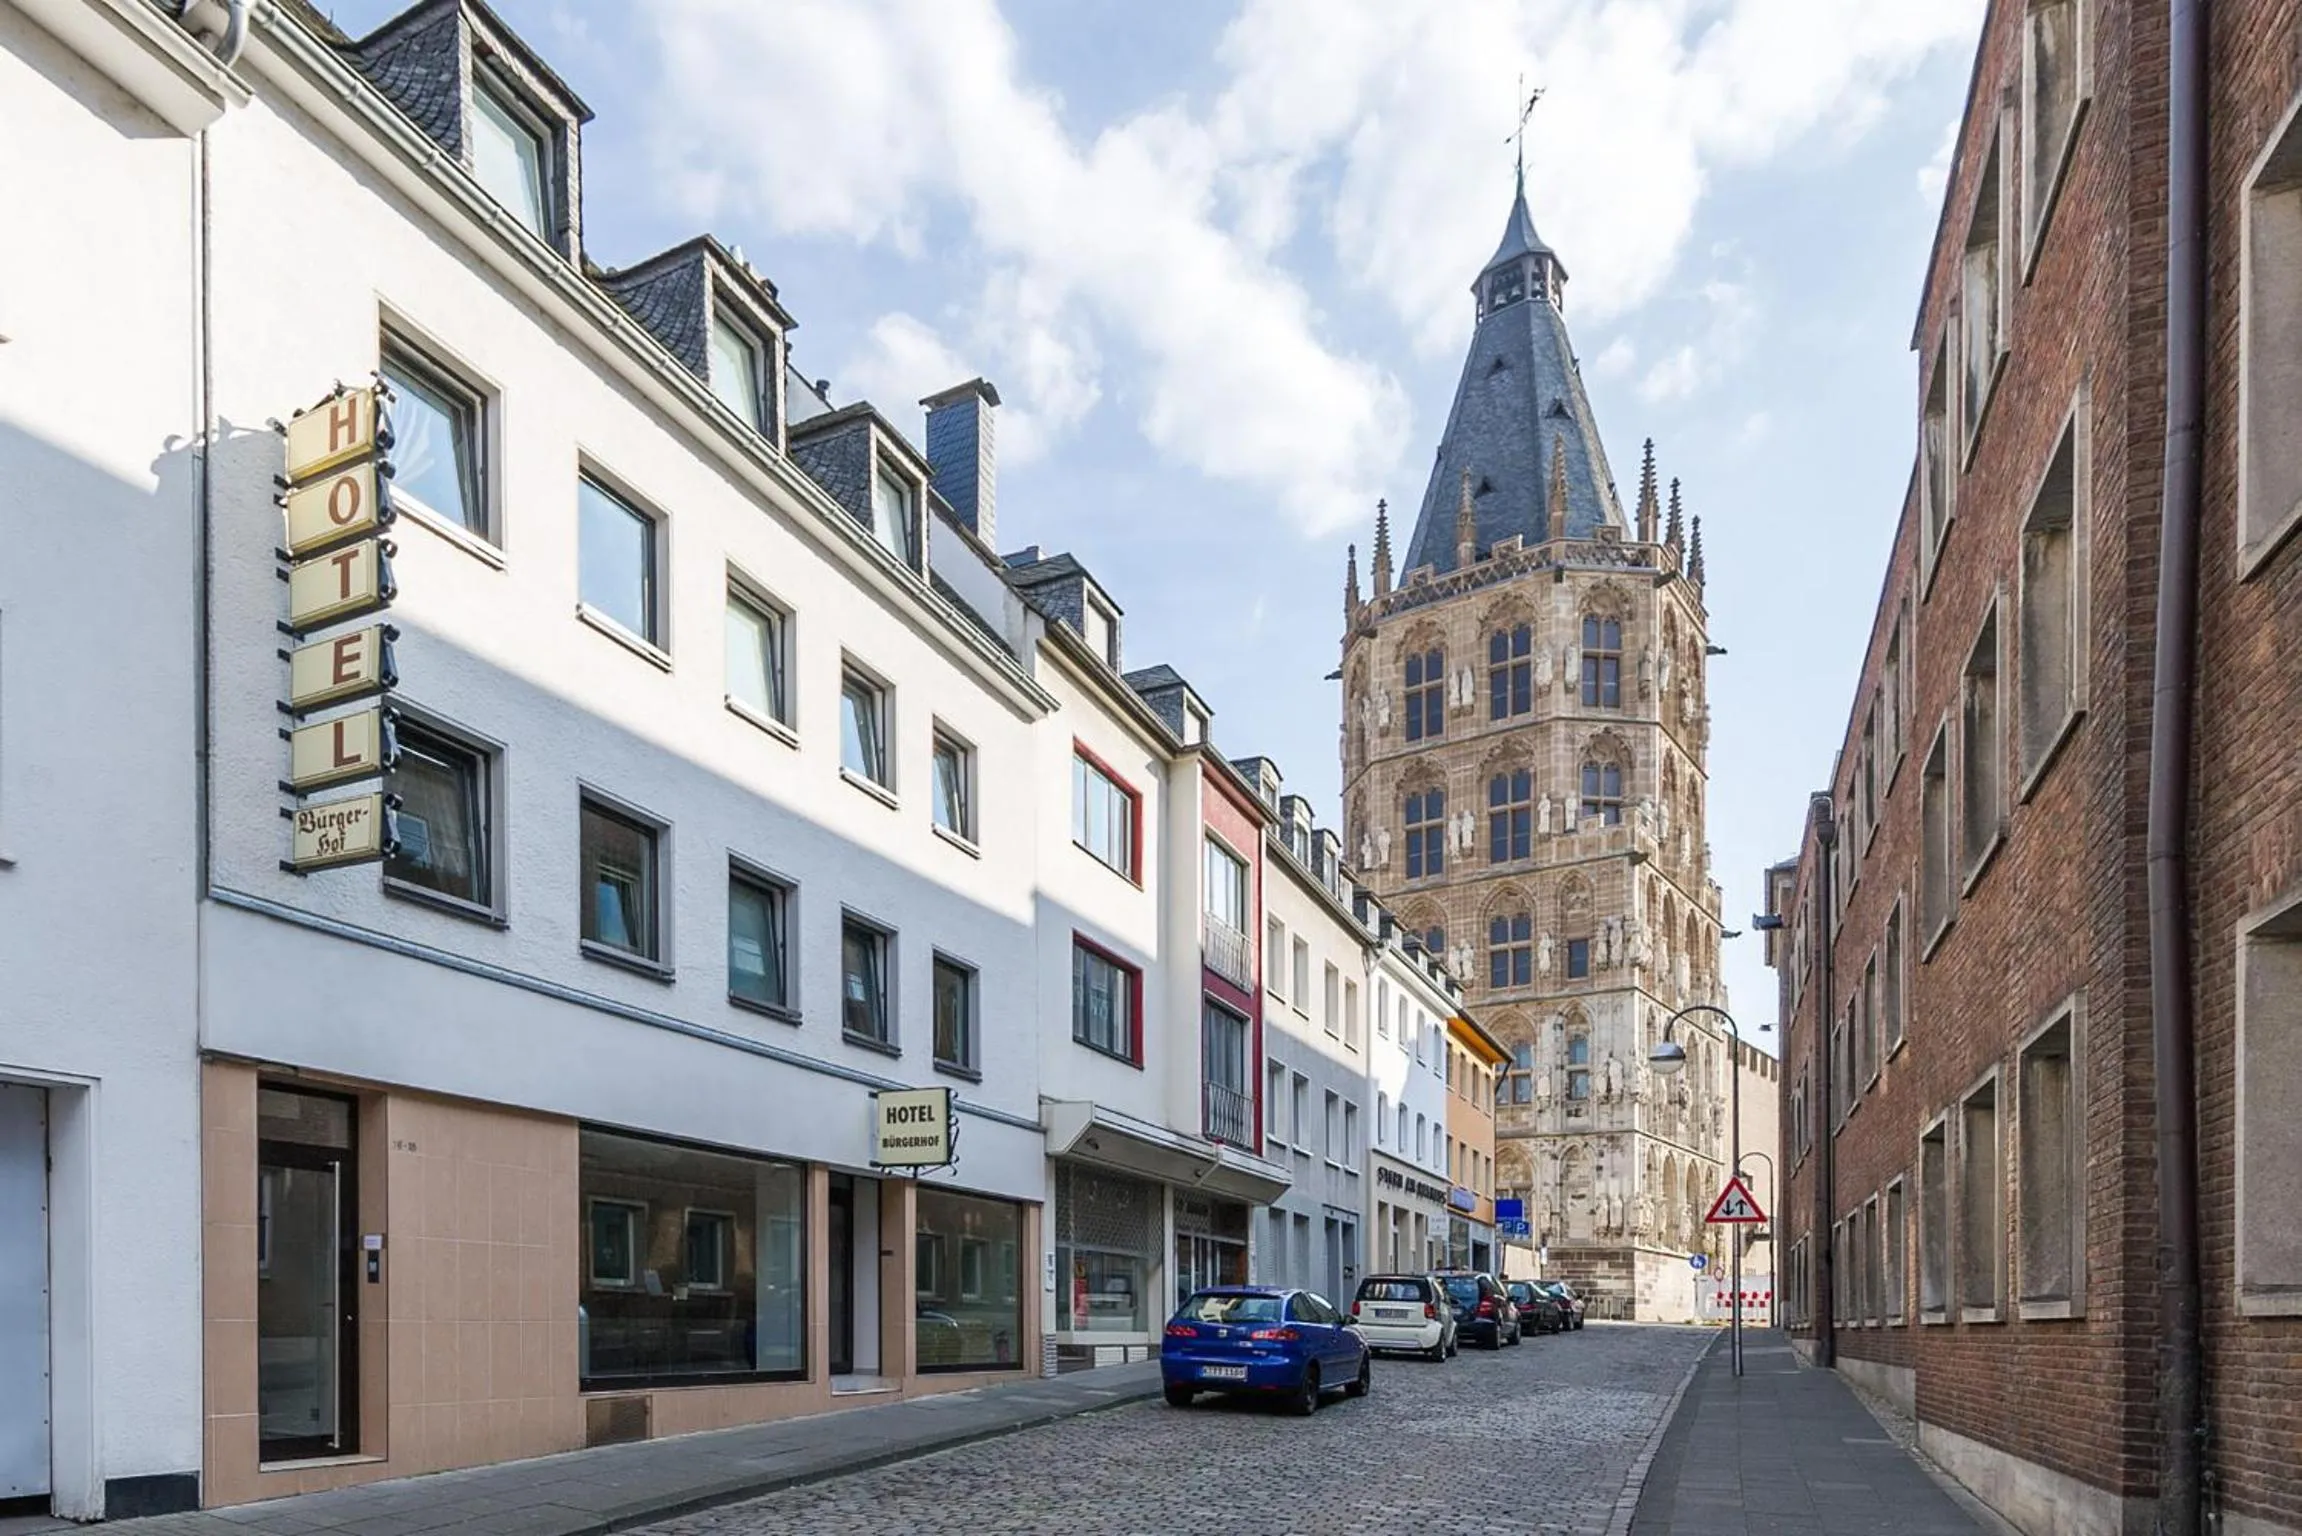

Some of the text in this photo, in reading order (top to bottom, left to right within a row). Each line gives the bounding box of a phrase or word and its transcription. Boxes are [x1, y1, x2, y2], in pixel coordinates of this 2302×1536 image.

[328, 396, 362, 769] HOTEL
[886, 1104, 936, 1125] HOTEL
[882, 1135, 940, 1149] BÜRGERHOF
